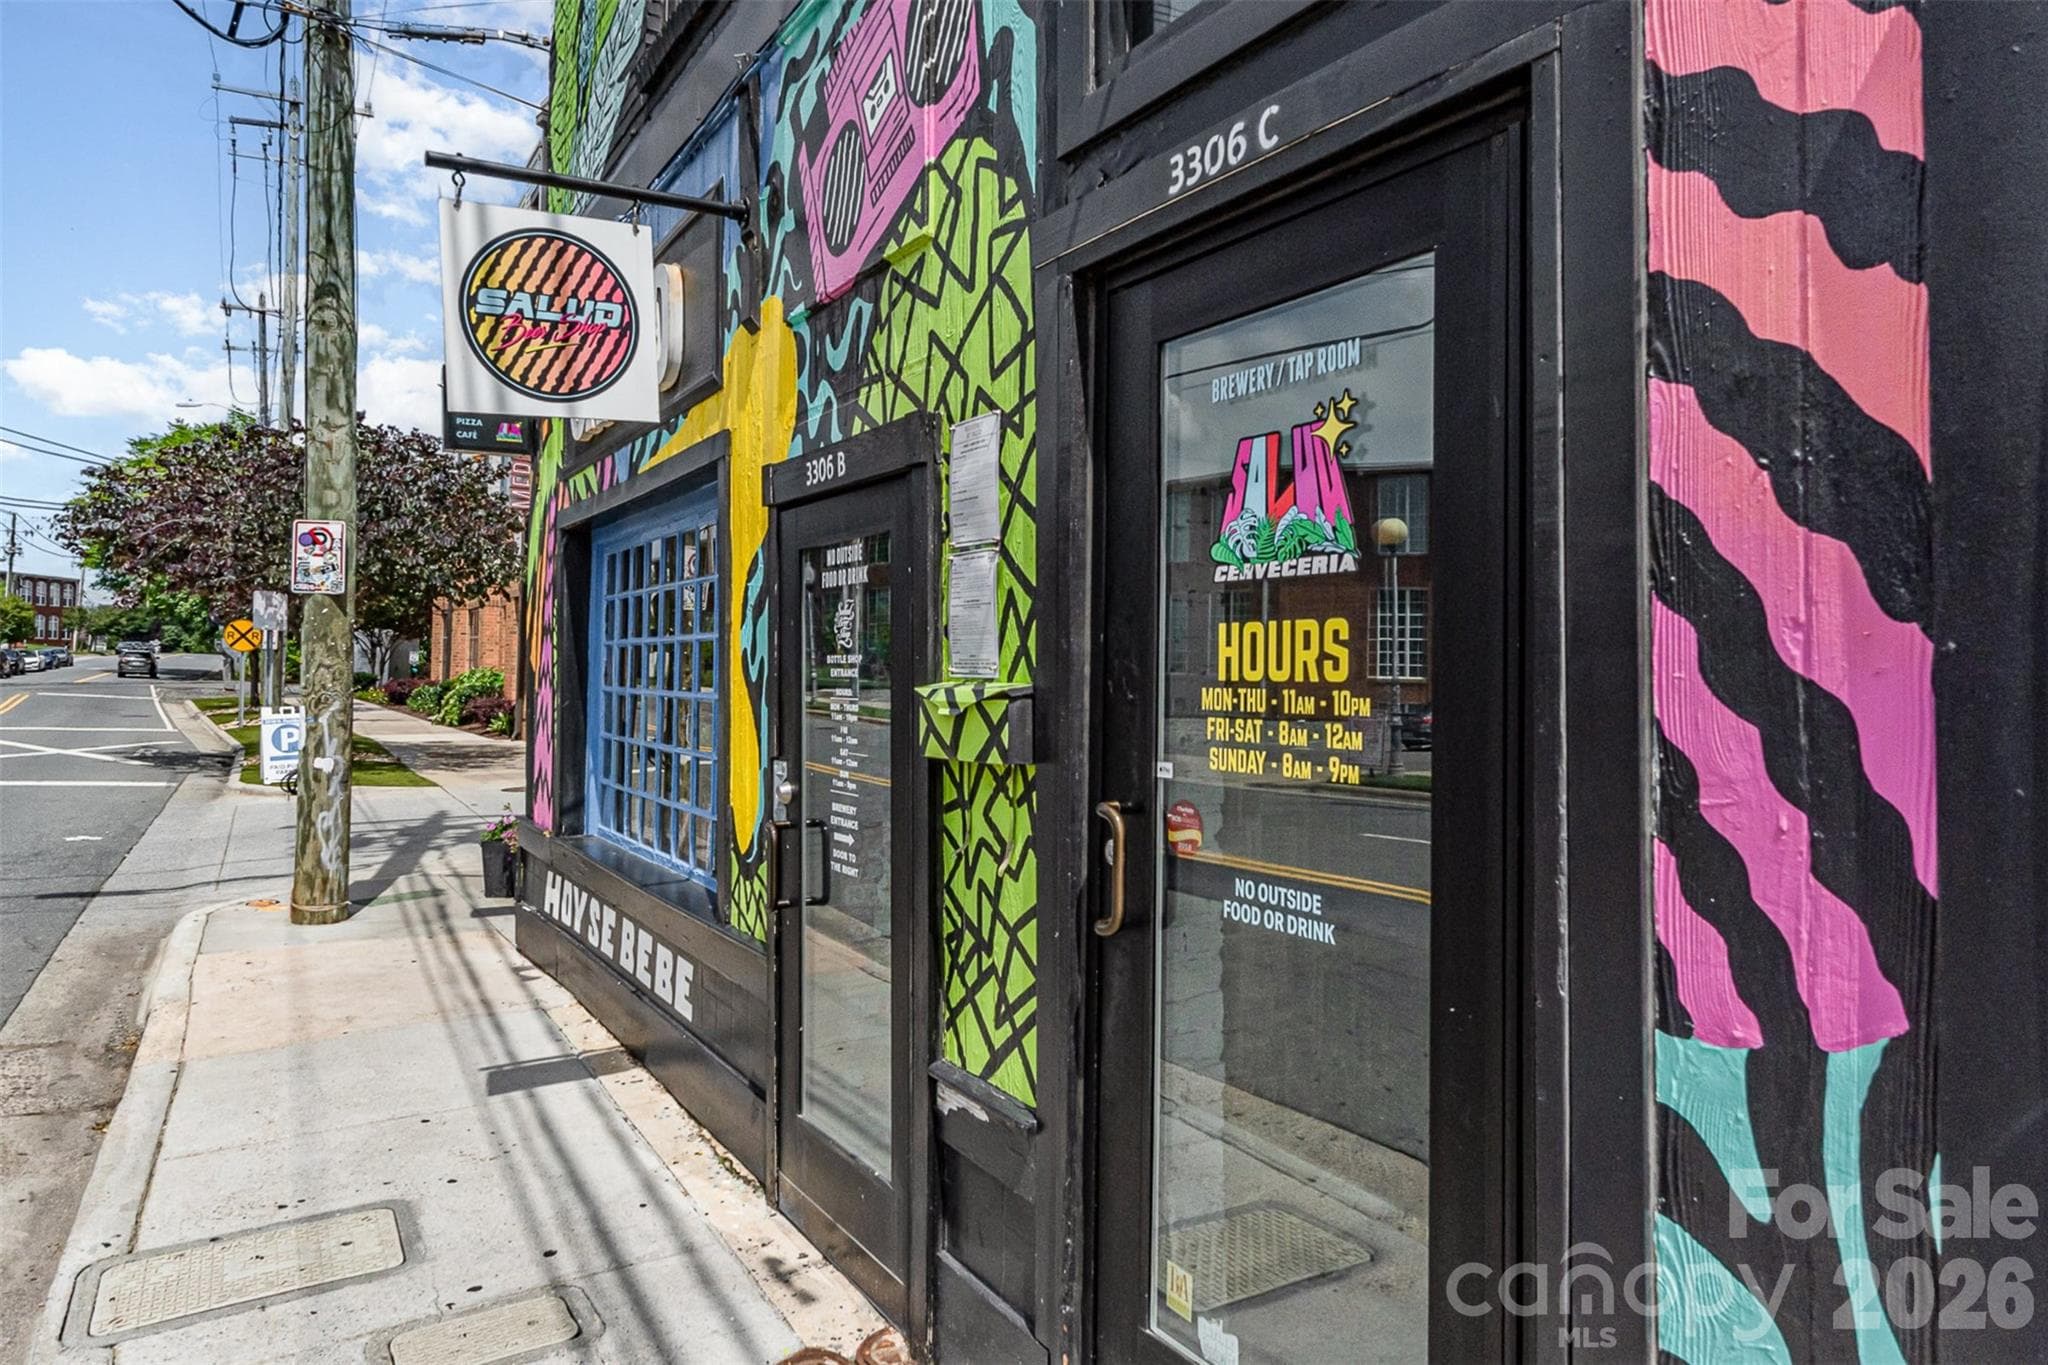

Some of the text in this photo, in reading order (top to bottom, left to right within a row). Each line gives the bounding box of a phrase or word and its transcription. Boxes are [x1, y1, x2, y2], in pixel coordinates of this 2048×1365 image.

[1168, 104, 1280, 195] 3306 C
[475, 288, 622, 328] SALUD
[492, 312, 608, 351] Beer Shop
[1212, 361, 1273, 404] BREWERY
[1287, 353, 1313, 383] TAP
[1316, 337, 1361, 376] ROOM
[456, 417, 483, 427] PIZZA
[806, 451, 846, 486] 3306 B
[836, 543, 863, 565] OUTSIDE
[1213, 553, 1359, 583] CERVECERIA
[822, 565, 869, 589] FOOD OR DRINK
[227, 632, 259, 640] R R
[1217, 617, 1350, 683] HOURS
[826, 654, 863, 664] BOTTLE SHOP
[830, 668, 858, 678] ENTRANCE
[1201, 687, 1266, 713] MON-THU
[1282, 689, 1315, 715] 11AM
[1332, 690, 1371, 717] 10PM
[1206, 718, 1263, 744] FRI-SAT
[1278, 723, 1308, 748] 8AM
[1325, 723, 1363, 752] 12AM
[1209, 747, 1266, 775] SUNDAY
[1282, 753, 1312, 780] 8AM
[1329, 756, 1360, 785] 9PM
[830, 815, 859, 831] ENTRANCE
[831, 801, 857, 817] BREWERY
[830, 860, 859, 878] THE RIGHT
[832, 848, 857, 864] DOOR TO
[1234, 877, 1322, 915] NO OUTSIDE
[1223, 899, 1336, 945] FOOD OR DRINK
[544, 870, 694, 1023] HOY SE BEBE
